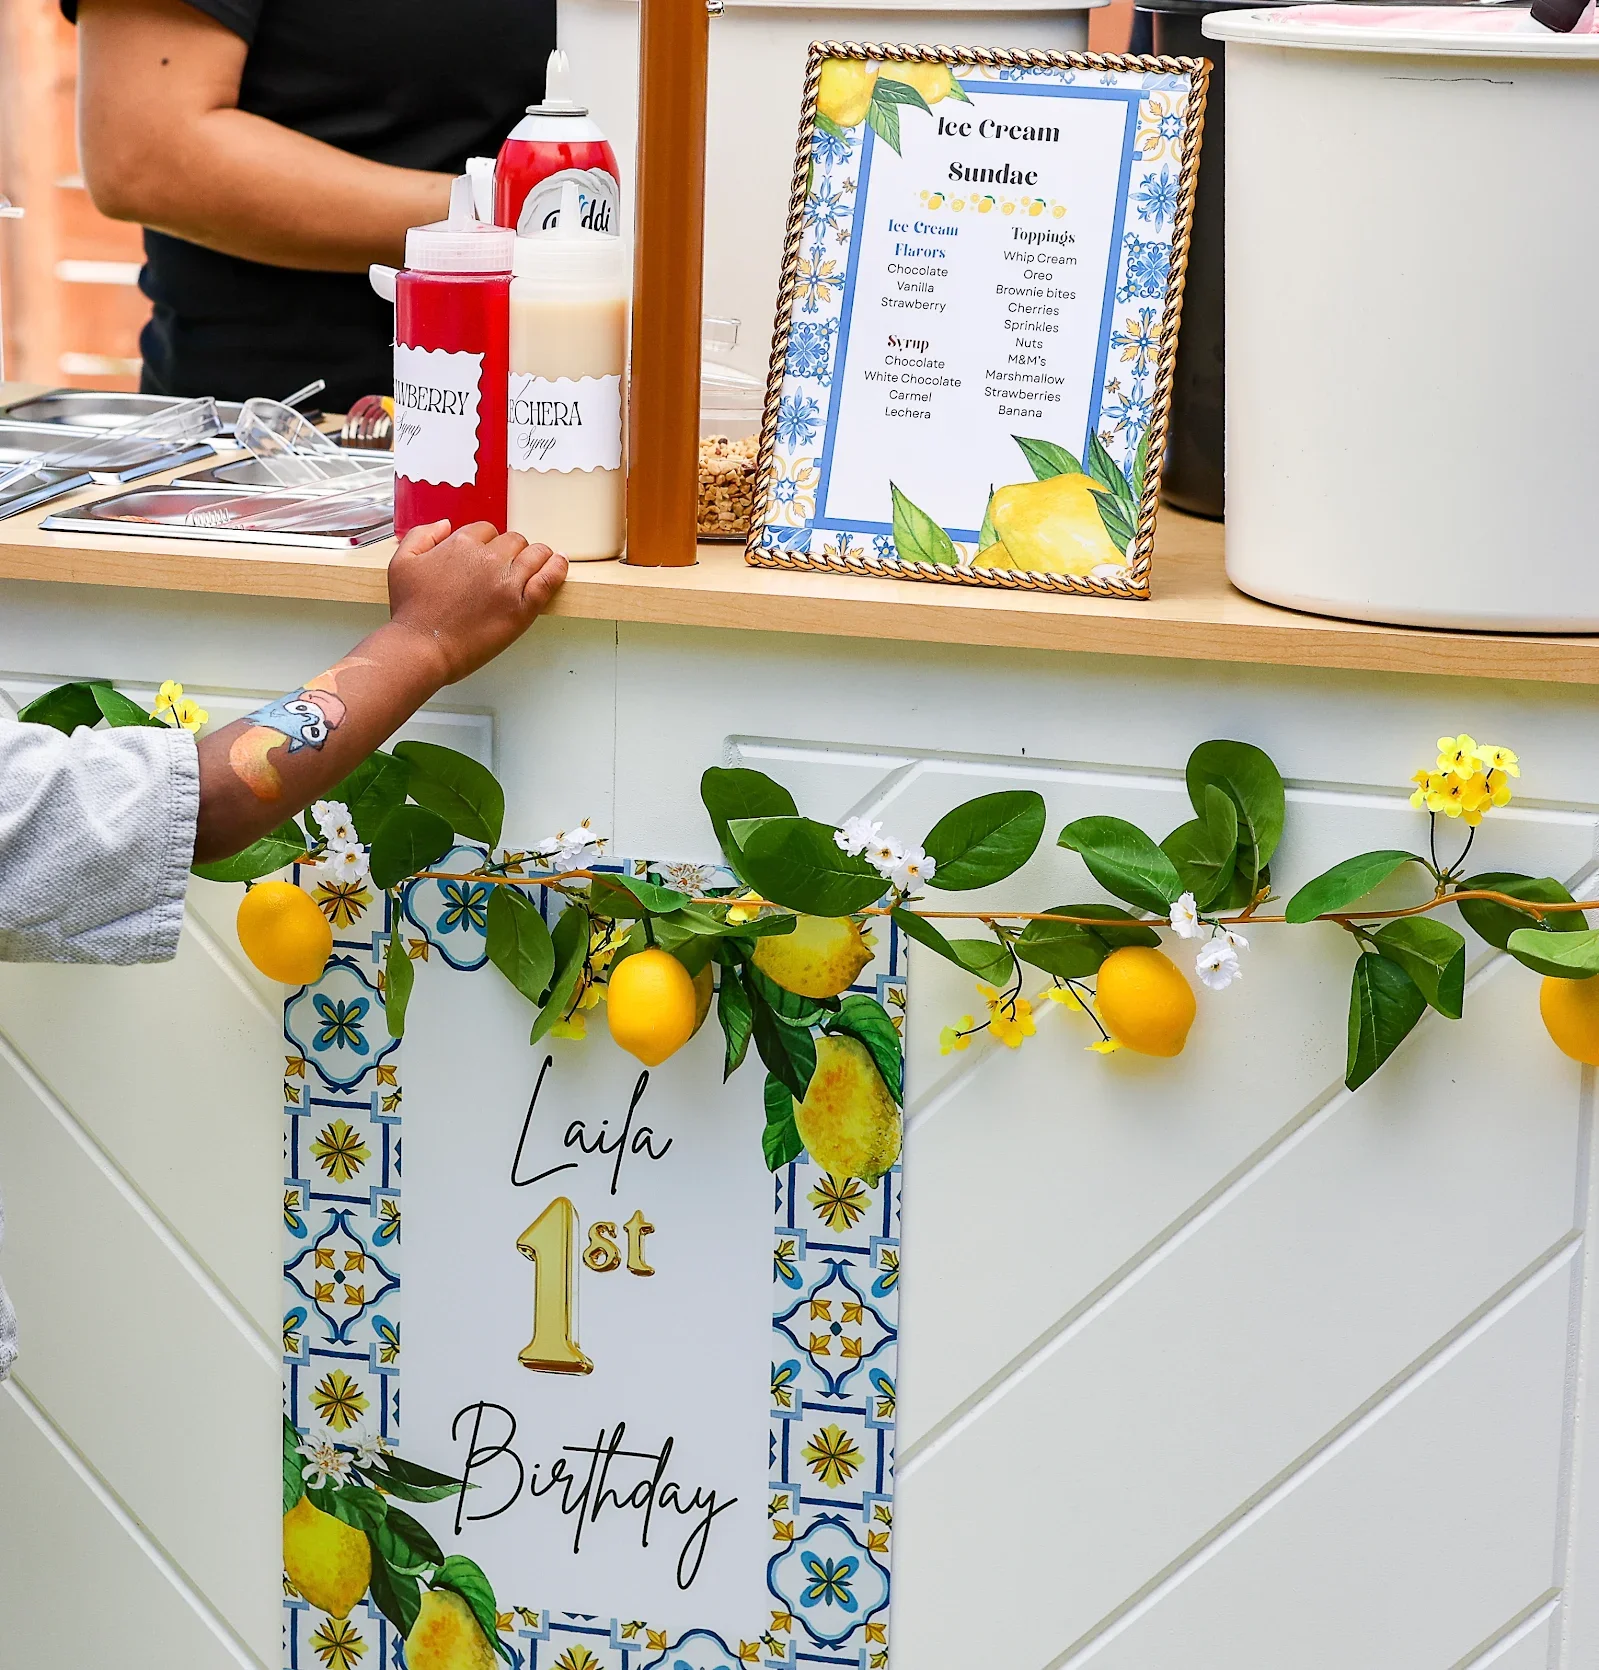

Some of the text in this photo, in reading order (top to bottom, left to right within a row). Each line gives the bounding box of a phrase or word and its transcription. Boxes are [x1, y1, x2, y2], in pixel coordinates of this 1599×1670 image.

[938, 116, 1060, 143] Ice Cream
[948, 161, 1038, 186] Sundae
[888, 218, 959, 237] Ice Cream
[1011, 226, 1076, 247] Toppings
[894, 242, 946, 259] Flavors
[1003, 250, 1077, 266] Whip Cream
[887, 263, 949, 278] Chocolate
[1023, 269, 1053, 281] Oreo
[897, 280, 935, 293] Vanilla
[995, 284, 1076, 300] Brownie bites
[881, 296, 947, 313] Strawberry
[1007, 302, 1060, 316] Cherries
[1003, 319, 1060, 333] Sprinkles
[887, 334, 930, 354] Syrup
[1015, 337, 1044, 349] Nuts
[884, 355, 946, 369] Chocolate
[1007, 354, 1047, 367] M&M's
[864, 370, 962, 388] White Chocolate
[985, 369, 1065, 385] Marshmallow
[889, 389, 932, 402] Carmel
[984, 386, 1061, 402] Strawberries
[885, 406, 932, 420] Lechera
[998, 404, 1043, 418] Banana
[395, 411, 422, 446] Syrup
[516, 425, 556, 460] Syrup
[511, 1055, 673, 1195] Laila
[516, 1196, 656, 1377] 1st
[452, 1401, 739, 1590] Birthday
